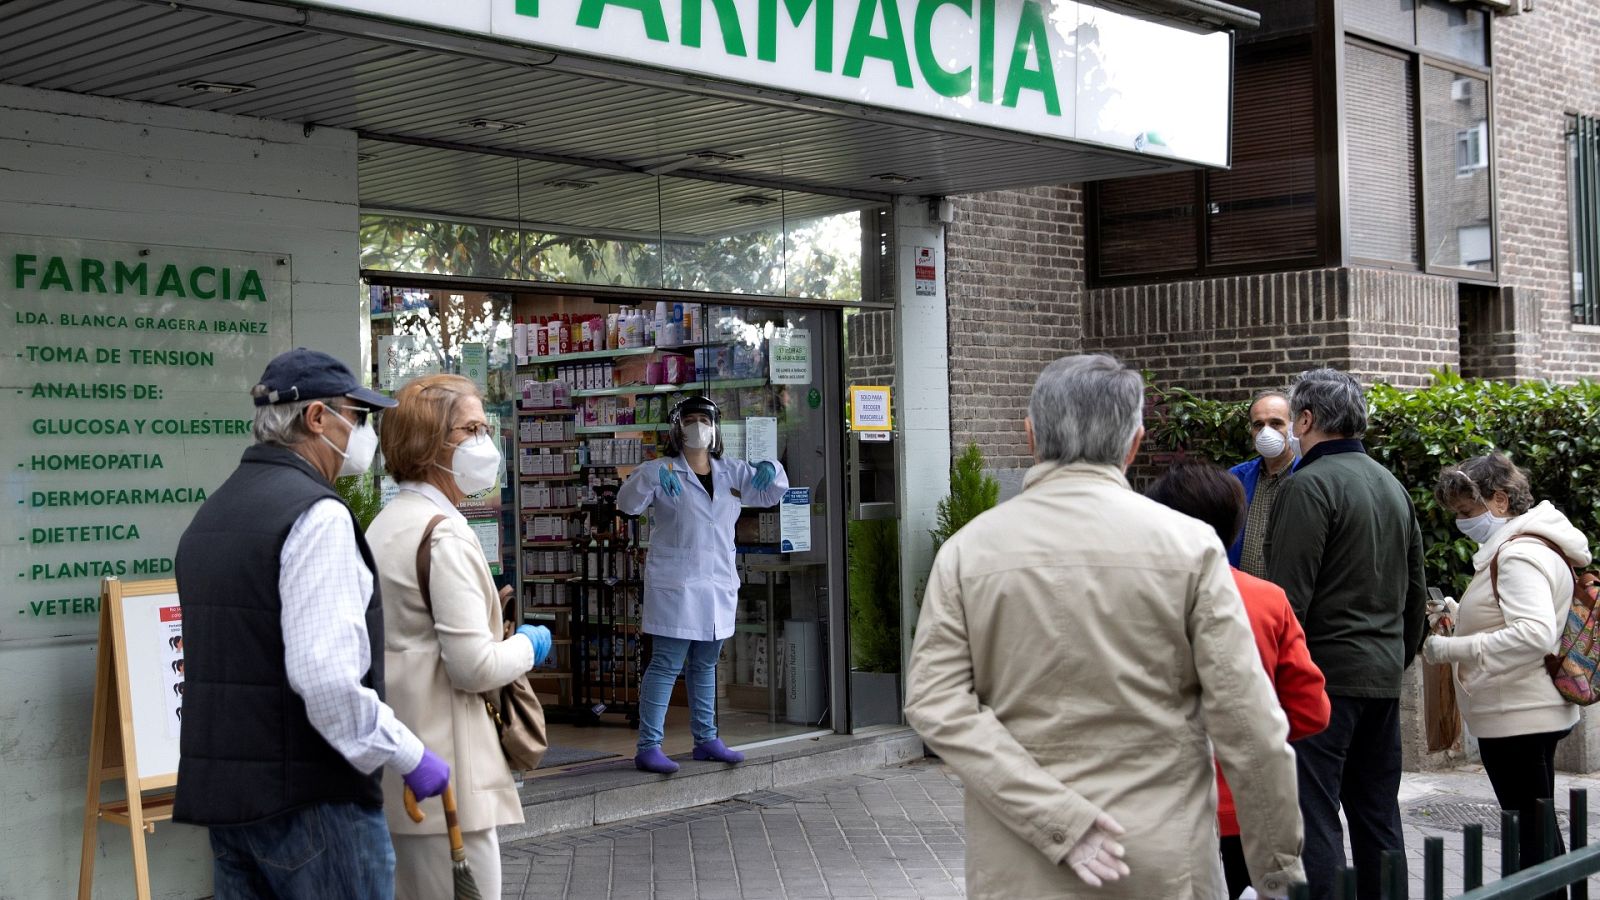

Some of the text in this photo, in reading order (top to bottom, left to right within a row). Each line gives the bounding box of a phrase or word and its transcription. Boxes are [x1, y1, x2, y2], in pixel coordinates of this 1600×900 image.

[515, 0, 1061, 116] MACIA
[15, 253, 267, 302] FARMACIA
[16, 312, 267, 334] LDA. BLANCA GRAGERA IBAÑEZ
[96, 348, 121, 364] DE
[129, 350, 214, 367] TENSION
[31, 383, 126, 400] ANALISIS
[133, 384, 163, 400] DE:
[32, 419, 130, 435] GLUCOSA
[134, 419, 146, 434] Y
[31, 454, 164, 471] HOMEOPATIA
[31, 487, 207, 507] DERMOFARMACIA
[32, 524, 140, 544] DIETETICA
[32, 559, 127, 580] PLANTAS
